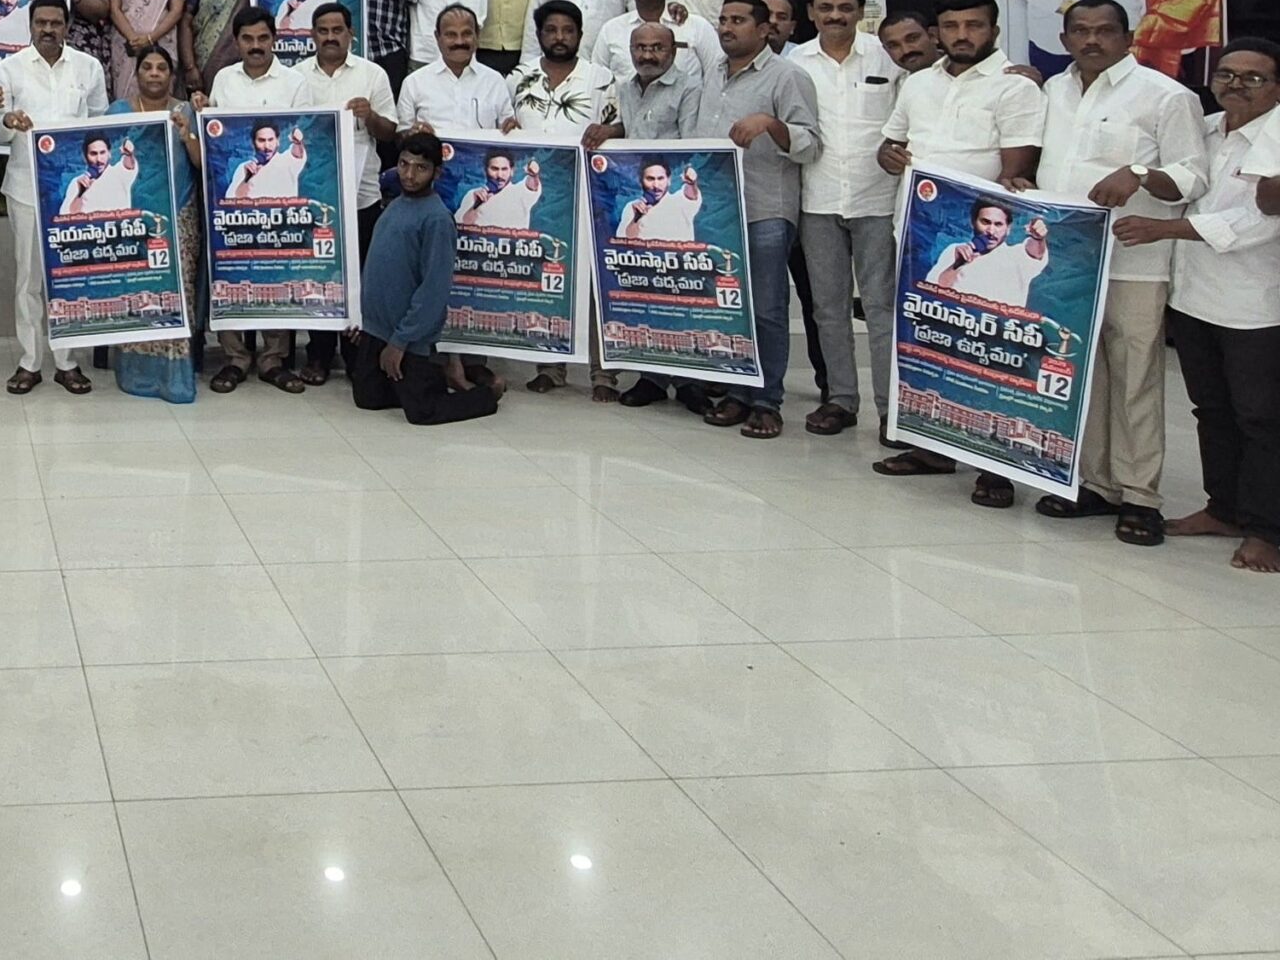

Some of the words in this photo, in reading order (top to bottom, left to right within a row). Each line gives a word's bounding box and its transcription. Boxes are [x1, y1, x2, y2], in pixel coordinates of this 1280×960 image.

[315, 240, 333, 255] 12
[150, 251, 168, 266] 12
[544, 275, 562, 290] 12
[719, 290, 740, 306] 12
[1040, 374, 1070, 398] 12
